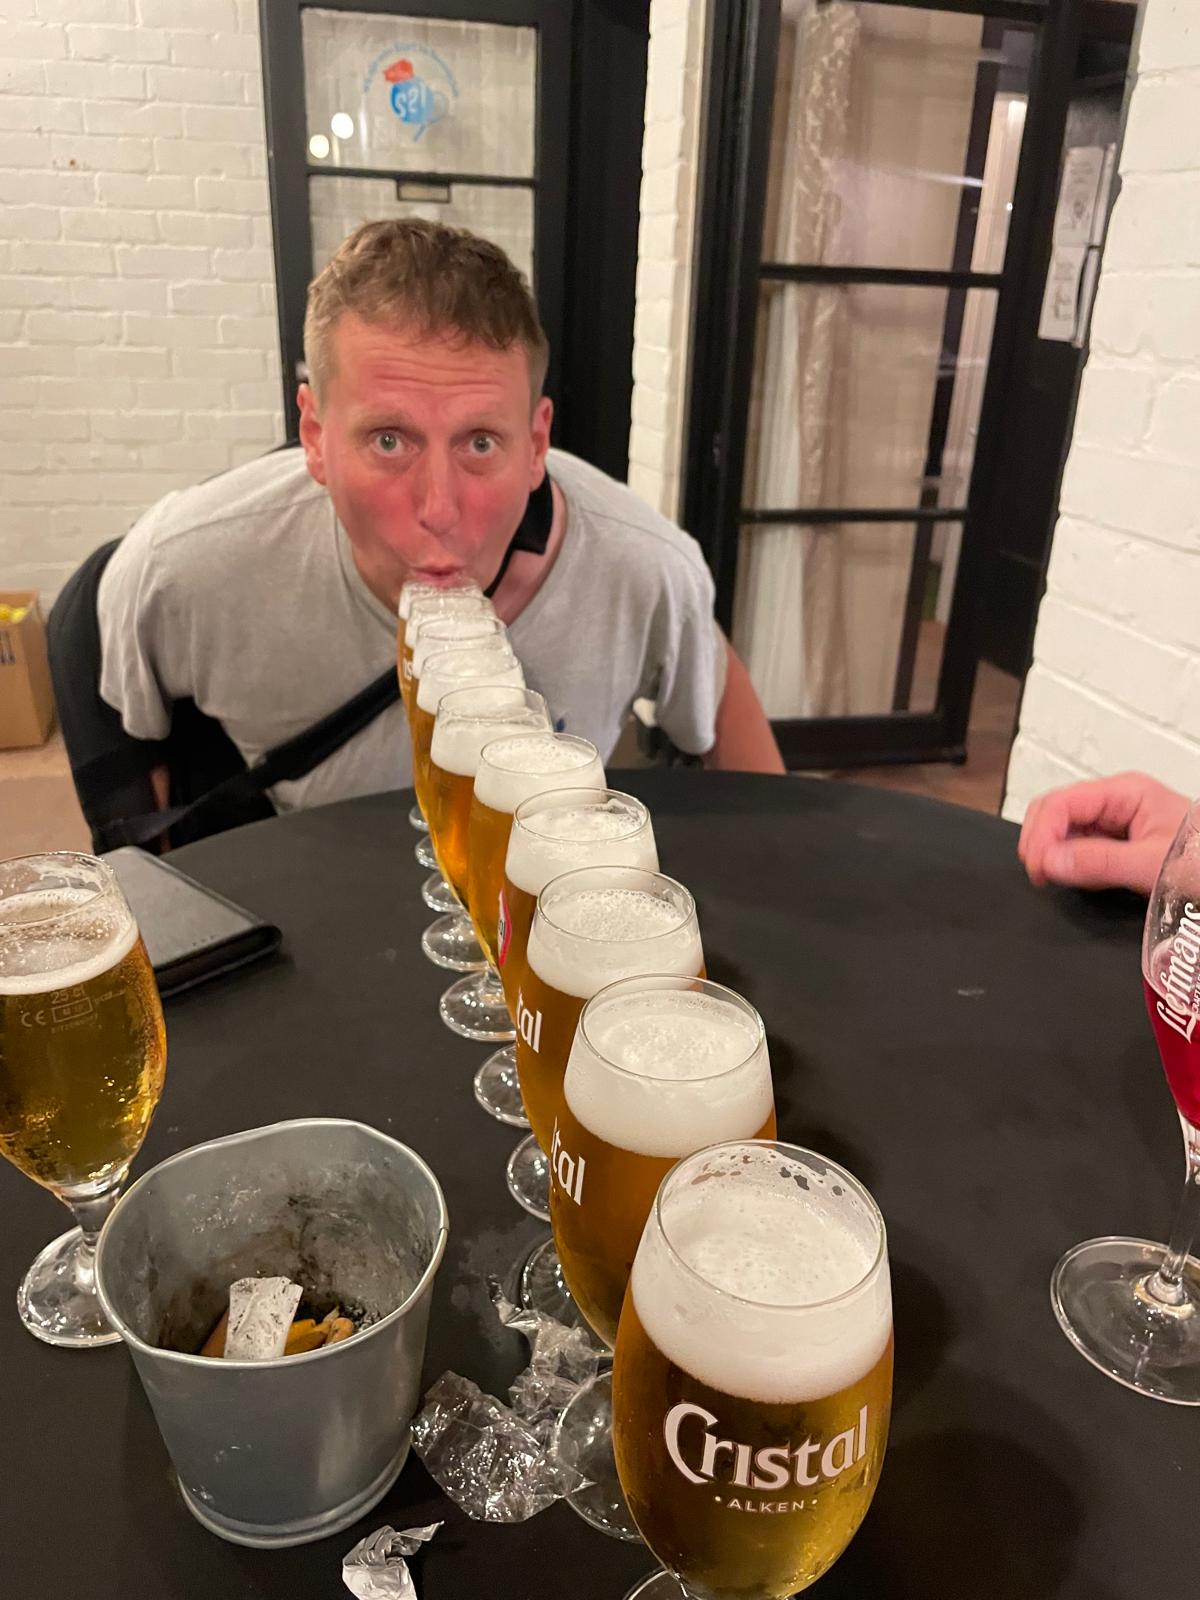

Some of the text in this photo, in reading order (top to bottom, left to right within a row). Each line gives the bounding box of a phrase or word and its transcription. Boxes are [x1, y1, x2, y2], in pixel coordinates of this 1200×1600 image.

[517, 985, 542, 1054] tal
[551, 1116, 586, 1207] tal
[664, 1402, 869, 1490] Cristal
[727, 1498, 805, 1514] ALKEN
